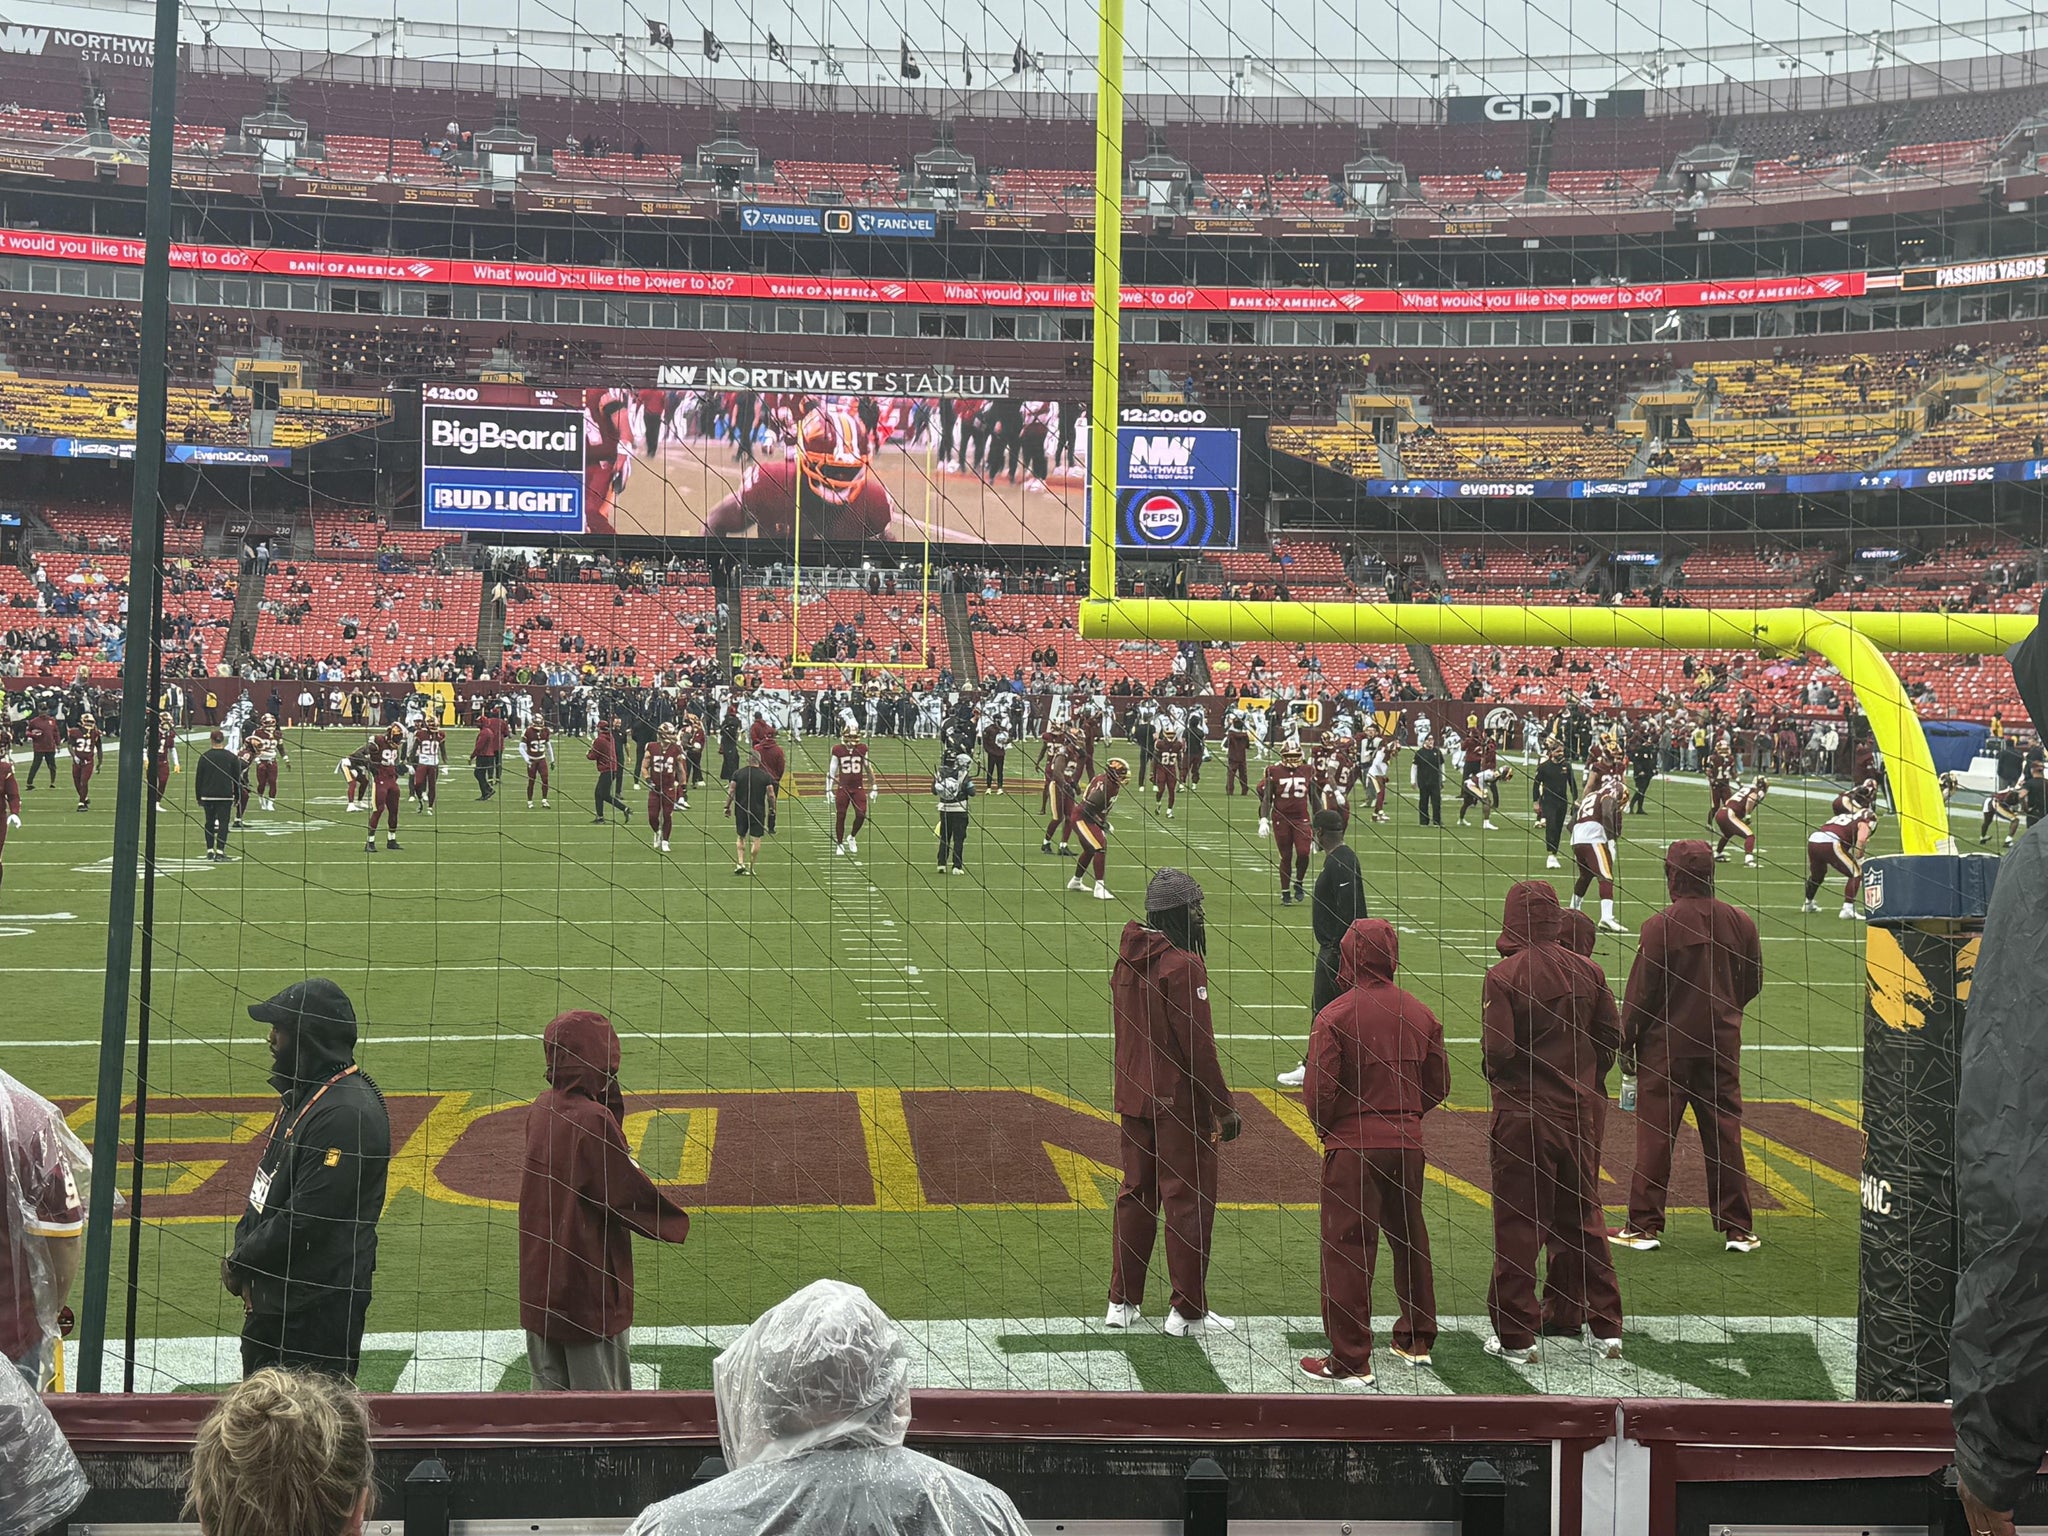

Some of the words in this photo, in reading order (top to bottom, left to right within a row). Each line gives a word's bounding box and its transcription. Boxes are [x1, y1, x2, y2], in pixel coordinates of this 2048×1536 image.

[54, 31, 184, 57] NORTHWET
[1484, 91, 1609, 121] GDIT
[307, 183, 318, 194] 17
[404, 189, 418, 199] 55
[641, 202, 654, 213] 68
[762, 214, 819, 226] FANDUEL
[877, 218, 932, 231] FANDUEL
[1194, 221, 1207, 231] 22
[9, 235, 55, 251] would
[60, 240, 87, 255] you
[91, 241, 119, 256] like
[123, 245, 145, 258] the
[201, 252, 217, 264] to
[221, 251, 249, 266] do?
[289, 260, 325, 272] BANK
[327, 262, 345, 273] OF
[347, 263, 406, 277] AMERICA
[1936, 263, 1997, 287] PASSING
[1998, 259, 2046, 279] YARDS
[473, 265, 512, 281] What
[514, 267, 557, 283] would
[560, 273, 586, 287] you
[589, 271, 614, 286] like
[618, 272, 641, 287] the
[645, 276, 687, 292] power
[690, 276, 706, 289] to
[708, 277, 735, 291] do?
[771, 285, 804, 295] BANK
[806, 286, 823, 296] OF
[825, 287, 879, 298] AMERICA
[943, 285, 979, 299] What
[981, 286, 1022, 301] would
[1025, 291, 1050, 305] you
[1053, 288, 1077, 302] like
[1080, 290, 1094, 302] th
[1151, 291, 1166, 304] to
[1168, 291, 1195, 304] do?
[1700, 290, 1736, 302] BANK
[1738, 288, 1755, 299] OF
[1756, 285, 1815, 299] AMERICA
[1230, 297, 1263, 308] BANK
[1265, 298, 1282, 308] OF
[1284, 297, 1338, 308] AMERICA
[1402, 294, 1439, 308] What
[1441, 293, 1482, 307] would
[1486, 296, 1512, 311] you
[1515, 292, 1540, 306] like
[1543, 292, 1567, 306] the
[1571, 293, 1615, 309] power
[1617, 290, 1632, 303] to
[1635, 288, 1663, 303] do?
[706, 367, 879, 391] NORTHWEST
[884, 373, 1010, 395] STADIUM
[426, 387, 479, 401] 42:00
[1120, 409, 1207, 424] 12:20:00
[431, 420, 577, 454] BigBear.ai
[194, 450, 268, 463] EventsDC.com
[1696, 481, 1766, 493] EventsDC.com
[435, 488, 492, 510] BUD
[495, 490, 573, 512] LIGHT
[1142, 513, 1180, 523] PEPSI
[231, 525, 246, 533] 229
[275, 527, 291, 535] 230
[1403, 555, 1417, 563] 235
[421, 741, 439, 755] 20
[530, 740, 546, 752] 35
[653, 755, 674, 773] 54
[840, 756, 862, 774] 56
[1279, 777, 1307, 799] 75
